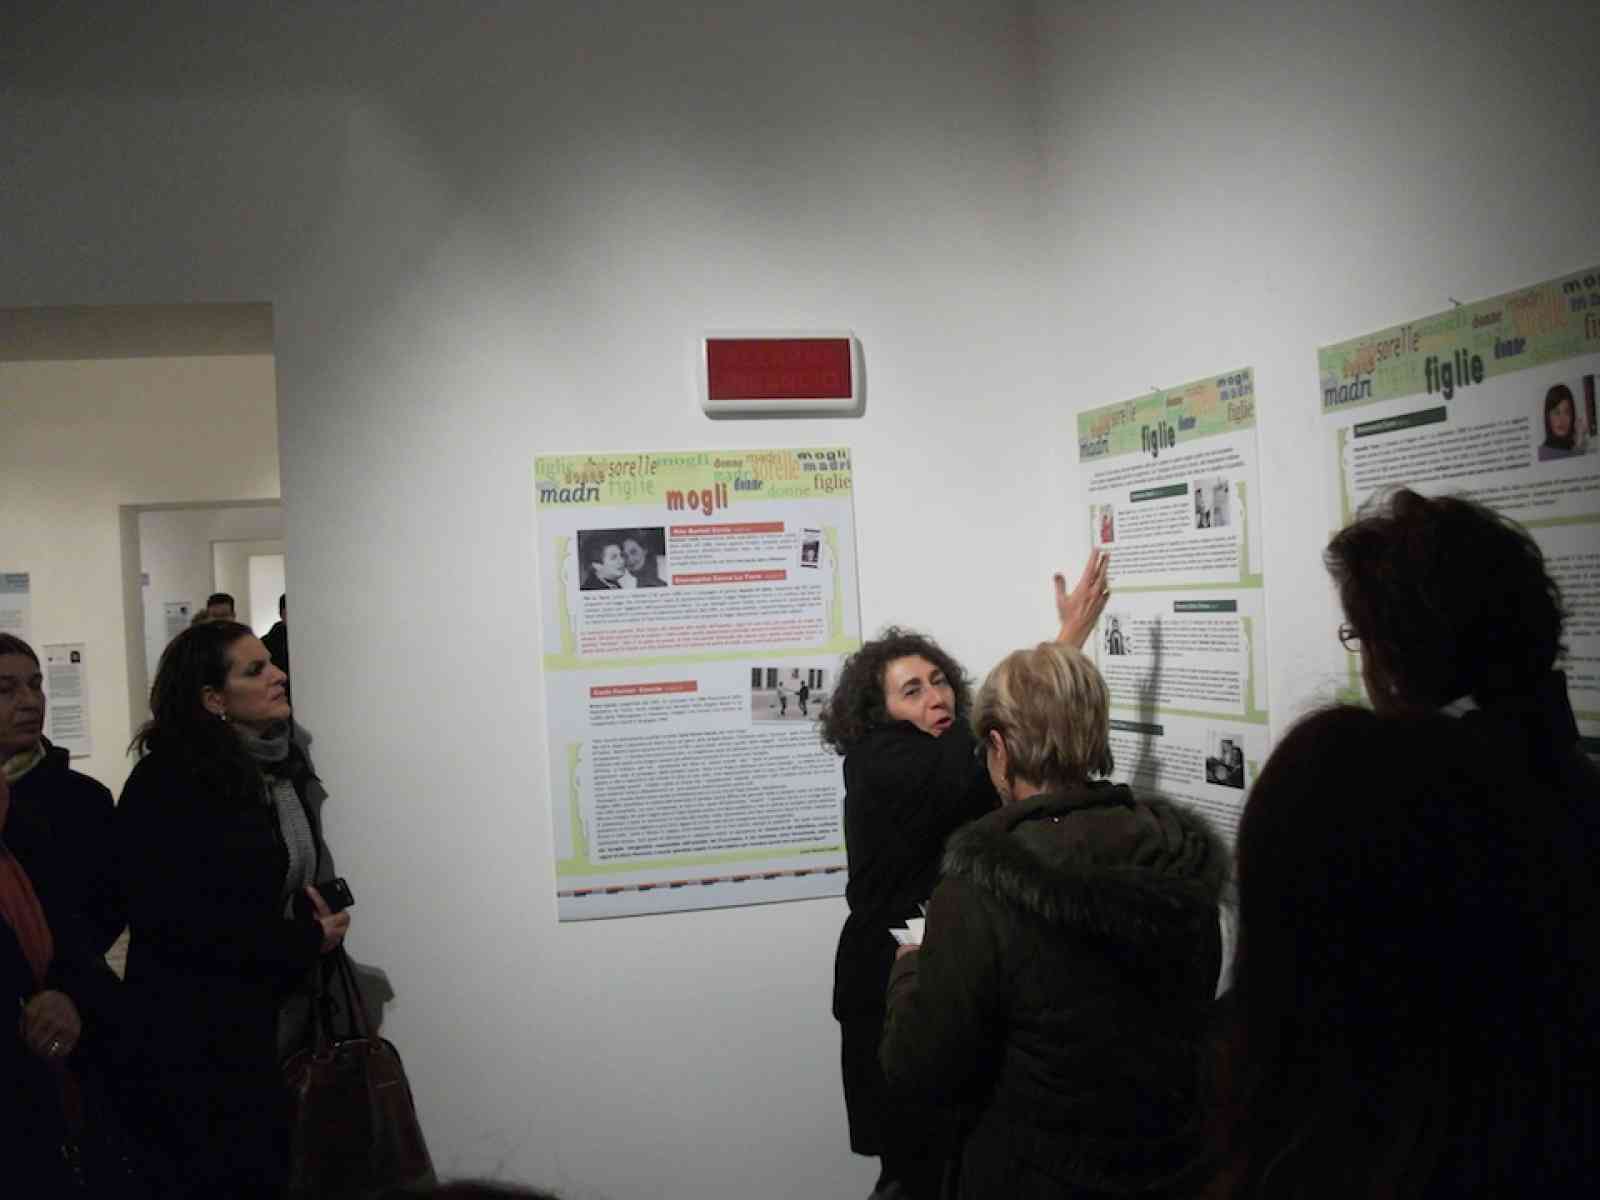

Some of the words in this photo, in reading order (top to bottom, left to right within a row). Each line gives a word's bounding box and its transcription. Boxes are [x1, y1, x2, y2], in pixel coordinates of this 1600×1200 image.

[1424, 347, 1484, 401] figlie
[1141, 418, 1177, 458] figlie
[608, 454, 657, 478] sorelle
[795, 449, 848, 462] mogli
[802, 459, 851, 472] madri
[813, 472, 852, 494] figlie
[664, 481, 729, 516] mogli
